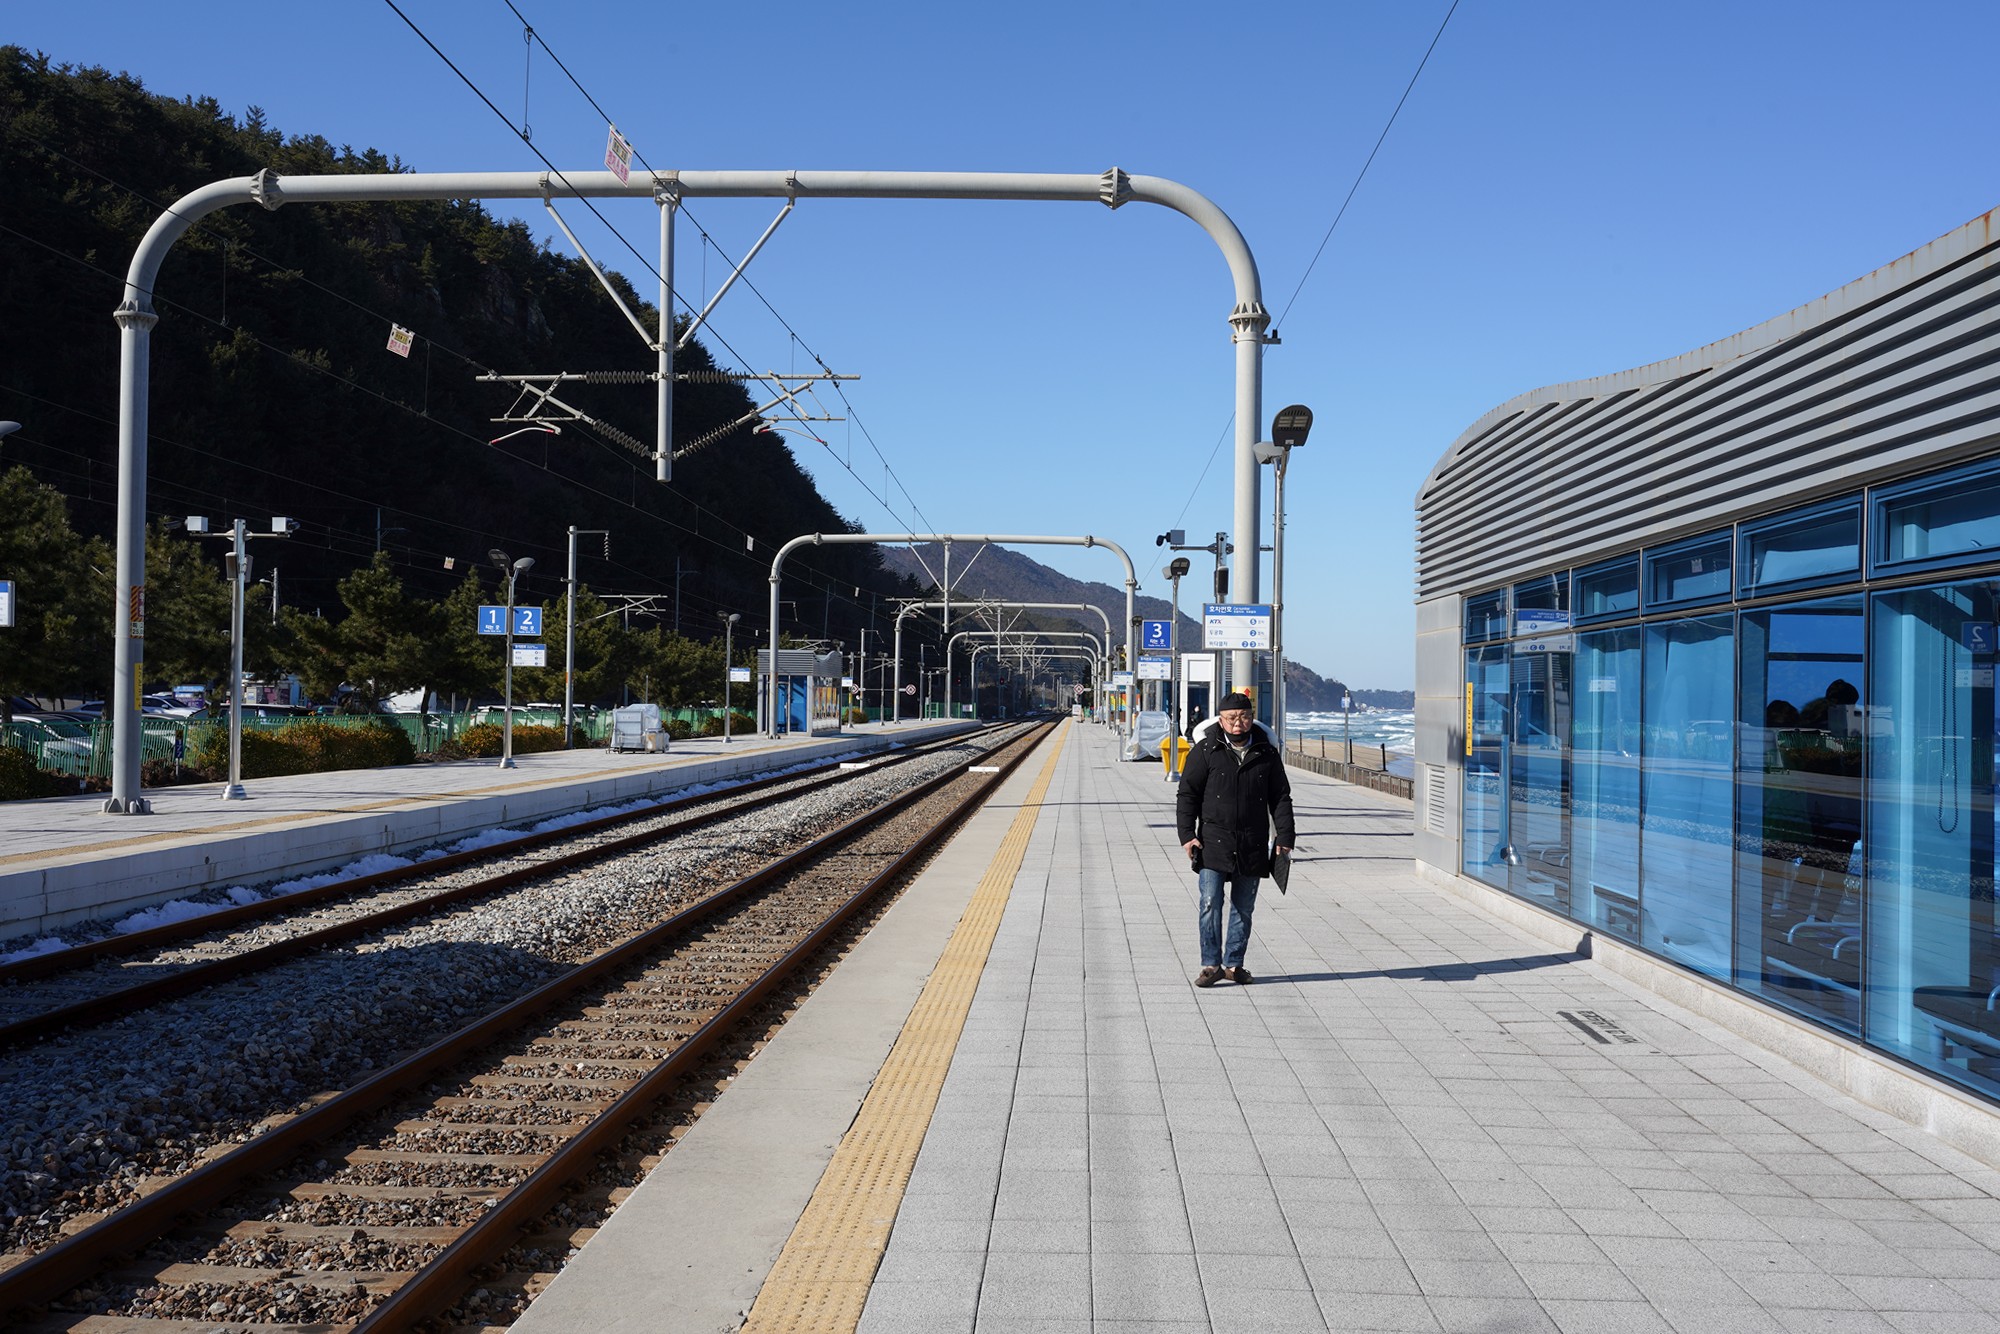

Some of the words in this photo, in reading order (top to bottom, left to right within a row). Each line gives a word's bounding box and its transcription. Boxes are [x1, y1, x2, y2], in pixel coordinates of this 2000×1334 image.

[489, 609, 496, 624] 1
[1209, 605, 1232, 613] 호차번호
[522, 610, 533, 625] 2
[1152, 623, 1163, 638] 3
